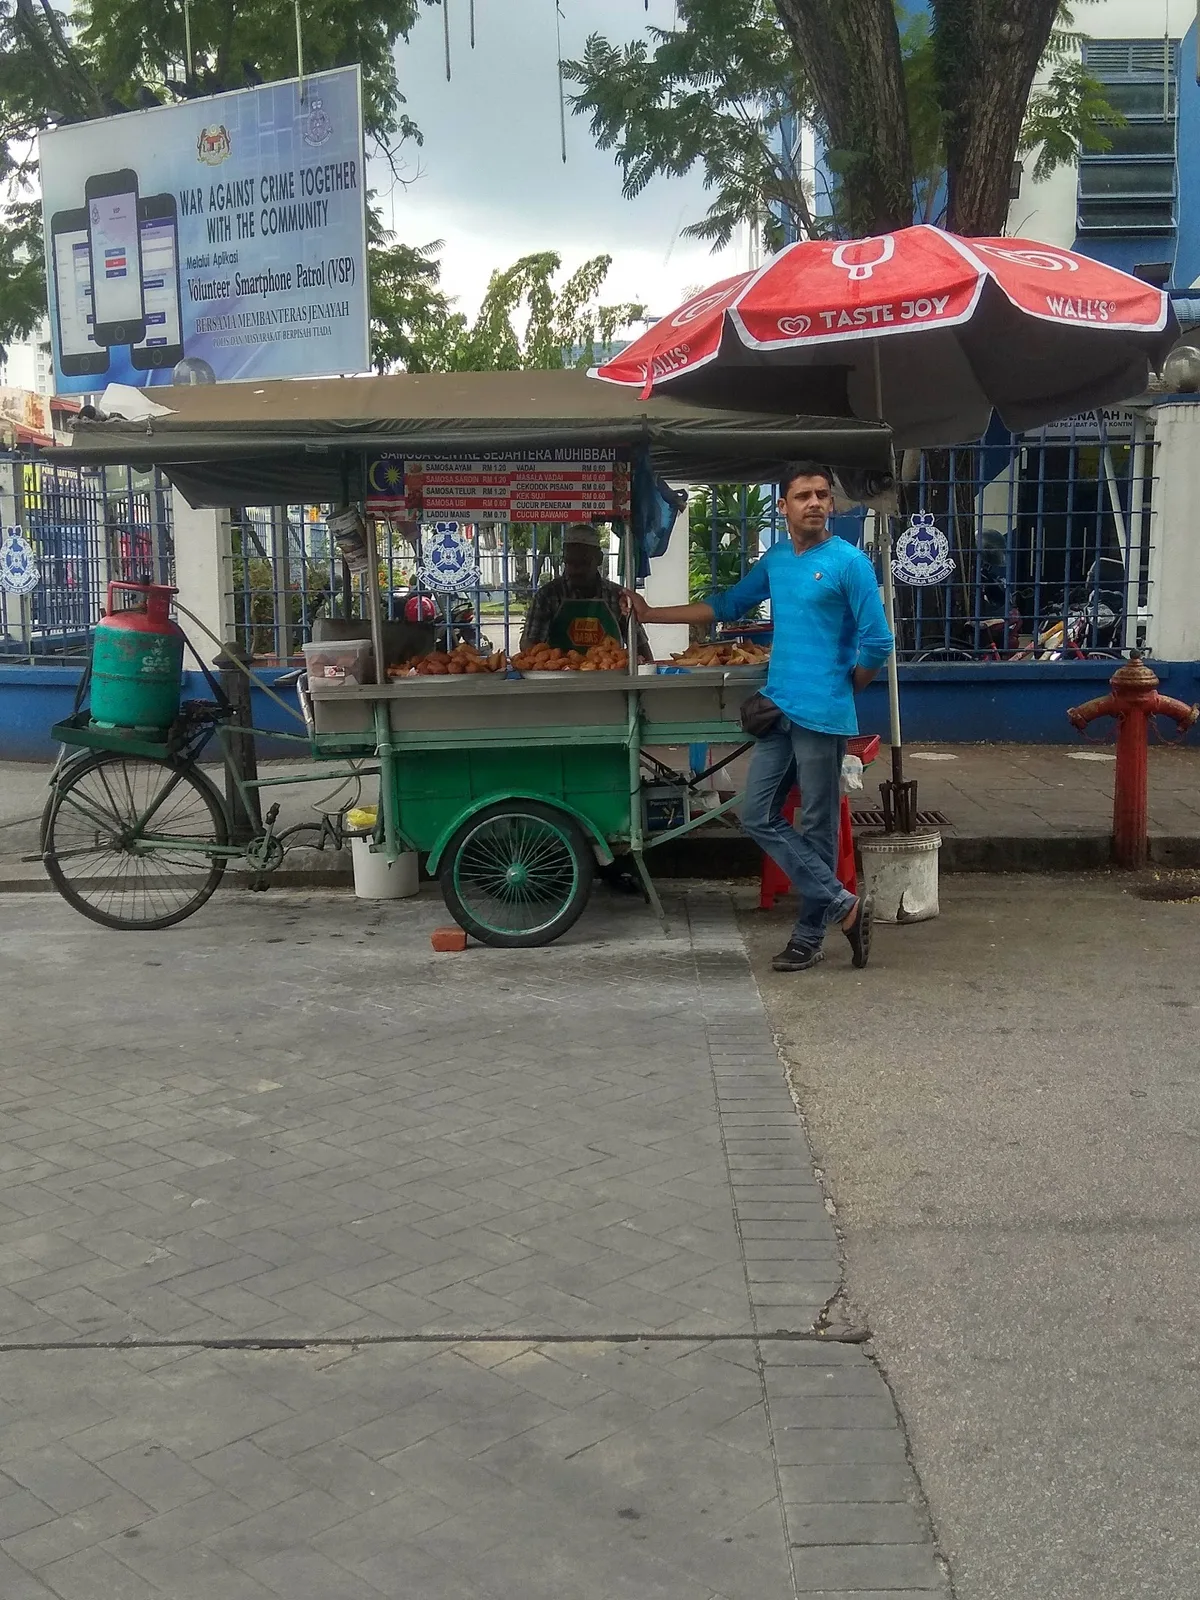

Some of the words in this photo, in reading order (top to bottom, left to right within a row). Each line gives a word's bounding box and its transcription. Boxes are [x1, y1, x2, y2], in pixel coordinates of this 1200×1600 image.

[179, 187, 204, 216] WAR
[209, 178, 255, 212] AGAINST
[260, 172, 295, 204] CRIME
[300, 161, 357, 197] TOGETHER
[206, 215, 231, 244] WITH
[237, 211, 255, 240] THE
[260, 199, 329, 236] COMMUNITY
[186, 254, 210, 270] Melalui
[213, 250, 239, 269] Aplikasi
[188, 278, 231, 301] Volunteer
[235, 268, 292, 299] Smartphone
[296, 261, 325, 288] Patrol
[328, 256, 355, 289] (VSP)
[195, 313, 237, 334] BERSAMA
[237, 305, 307, 329] MEMBANTERAS
[307, 301, 350, 324] JENAYAH
[819, 304, 894, 329] TASTE
[900, 295, 950, 319] JOY
[1046, 295, 1109, 321] WALL'S
[213, 337, 230, 348] POLIS
[230, 335, 245, 346] DAN
[245, 330, 282, 344] MASYARAKAT
[282, 327, 312, 341] BERPISAH
[313, 325, 332, 338] TIADA
[483, 449, 552, 460] SEJAHTERA
[554, 448, 616, 460] MUHIBBAH
[426, 464, 454, 472] SAMOSA
[454, 464, 472, 472] AYAM
[482, 464, 493, 472] RM
[494, 464, 507, 472] 1.20
[426, 475, 455, 483] SAMOSA
[455, 475, 479, 483] SARDIN
[482, 475, 493, 483] RM
[494, 475, 507, 483] 1.20
